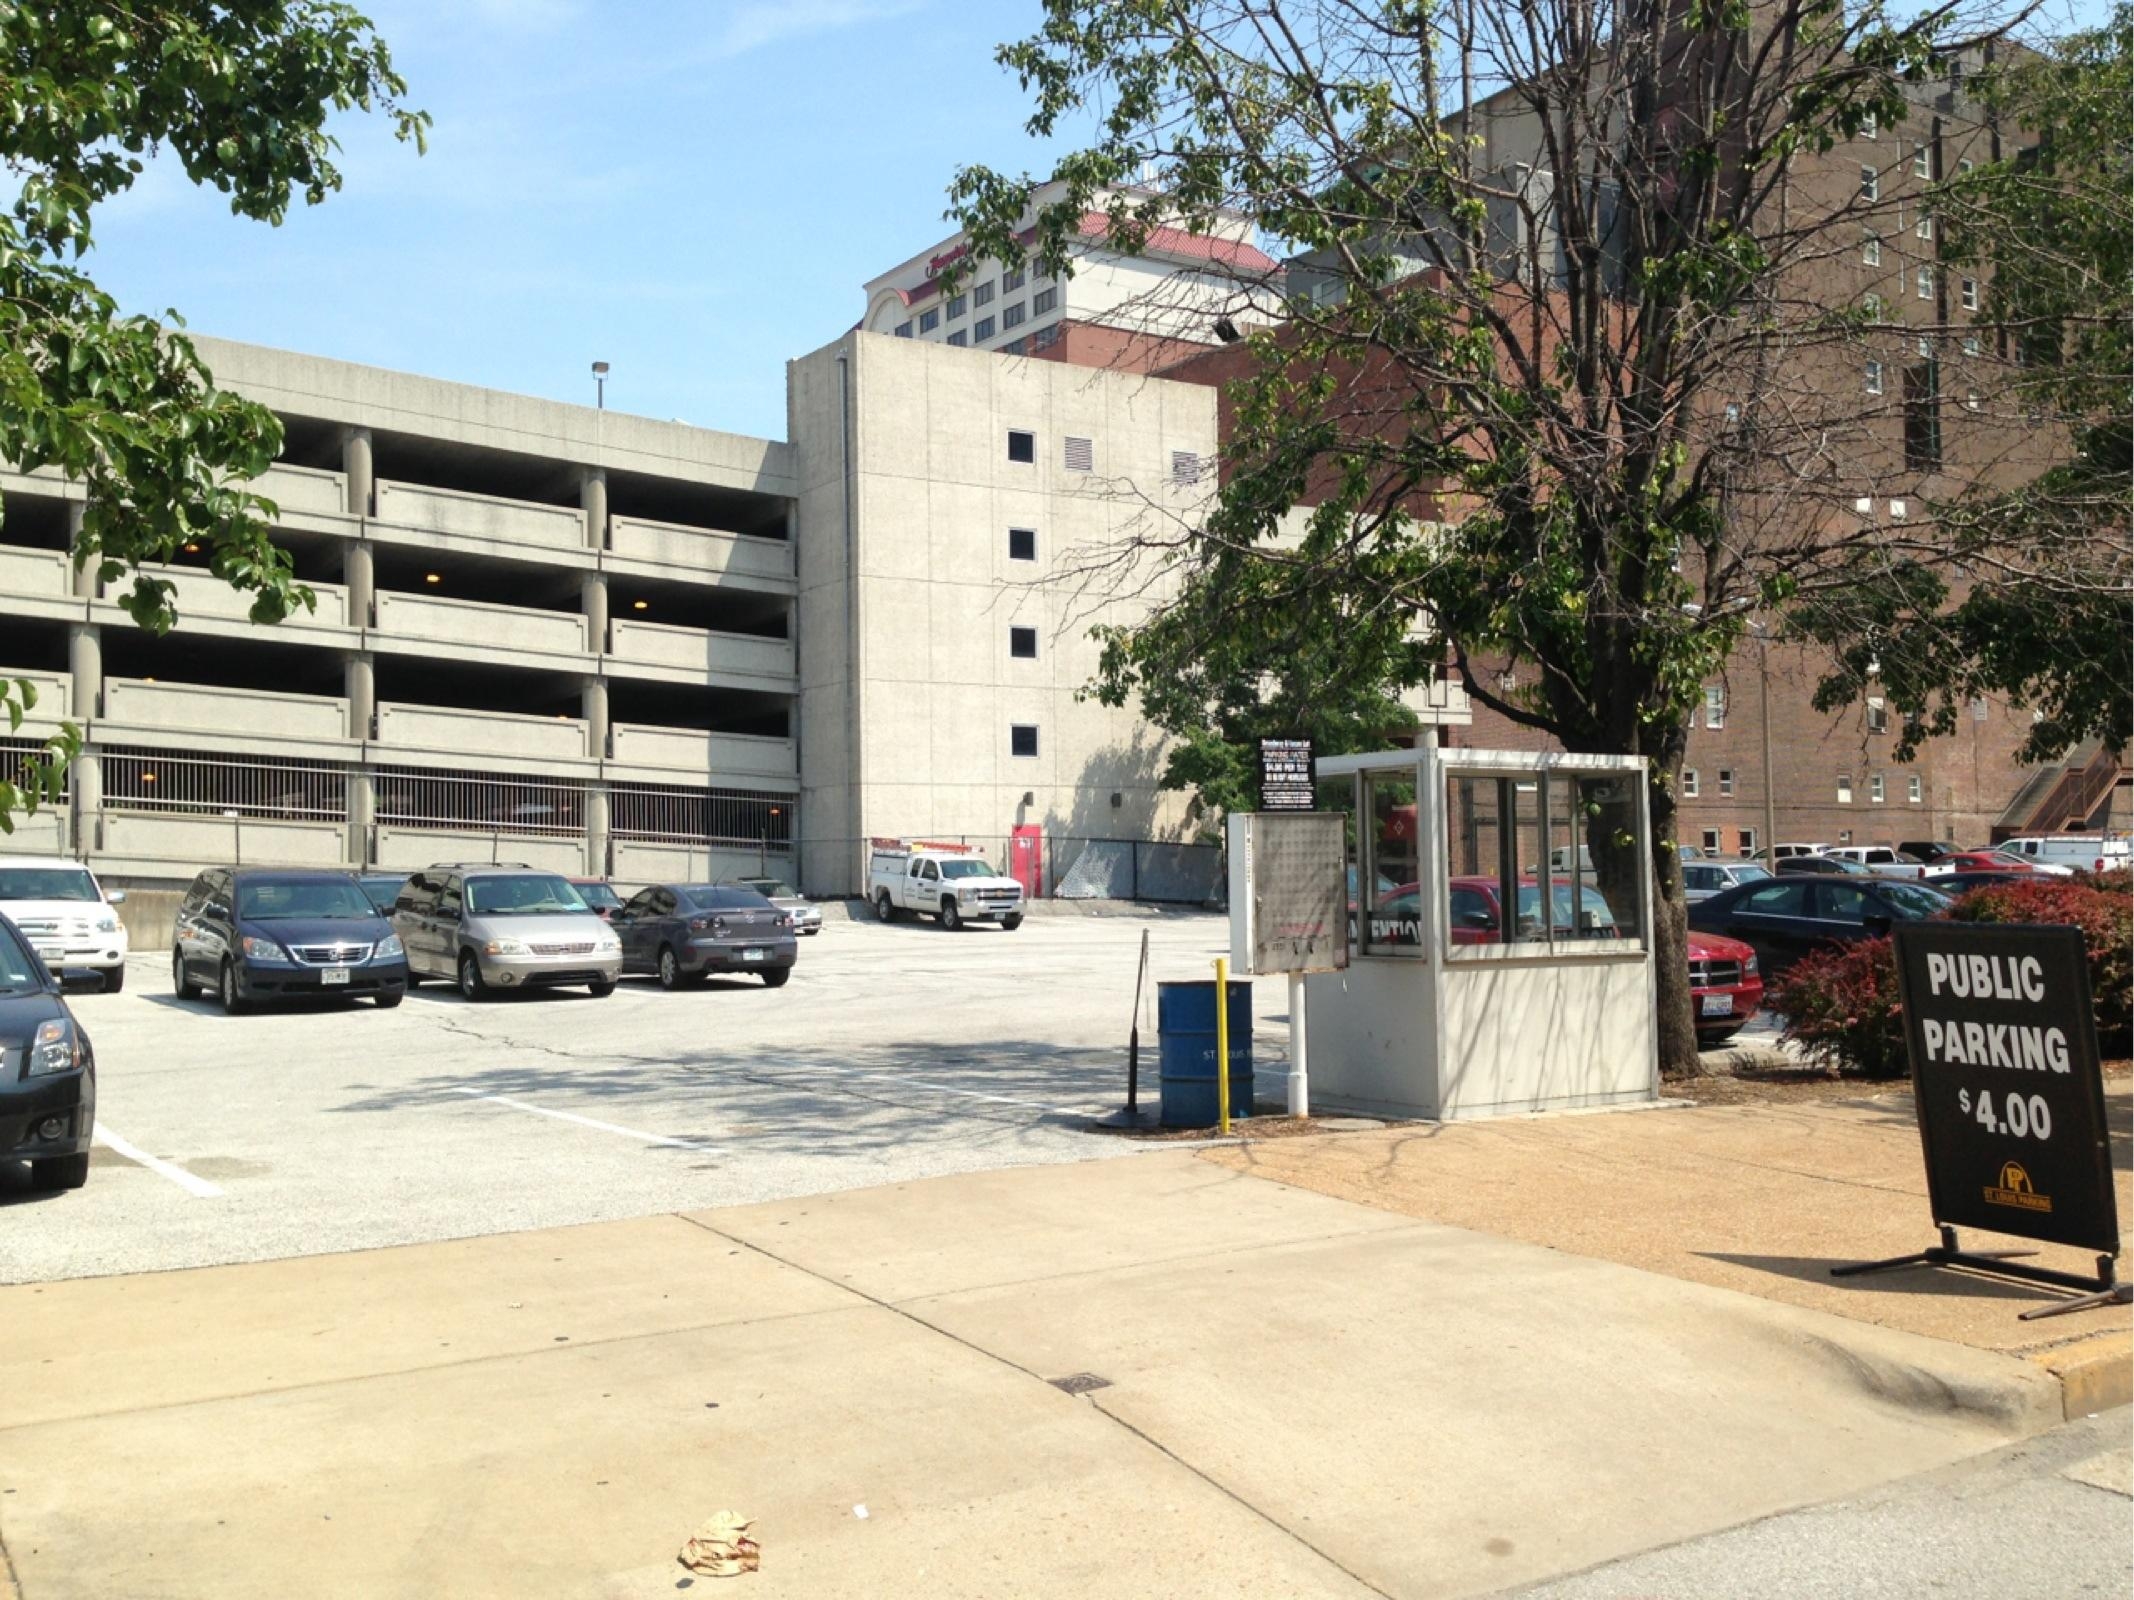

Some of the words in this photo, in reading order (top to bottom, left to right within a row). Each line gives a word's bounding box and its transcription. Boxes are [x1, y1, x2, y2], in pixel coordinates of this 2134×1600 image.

[1926, 952, 2045, 1002] PUBLIC
[1922, 1018, 2071, 1073] PARKING
[1958, 1087, 2052, 1140] $4.00
